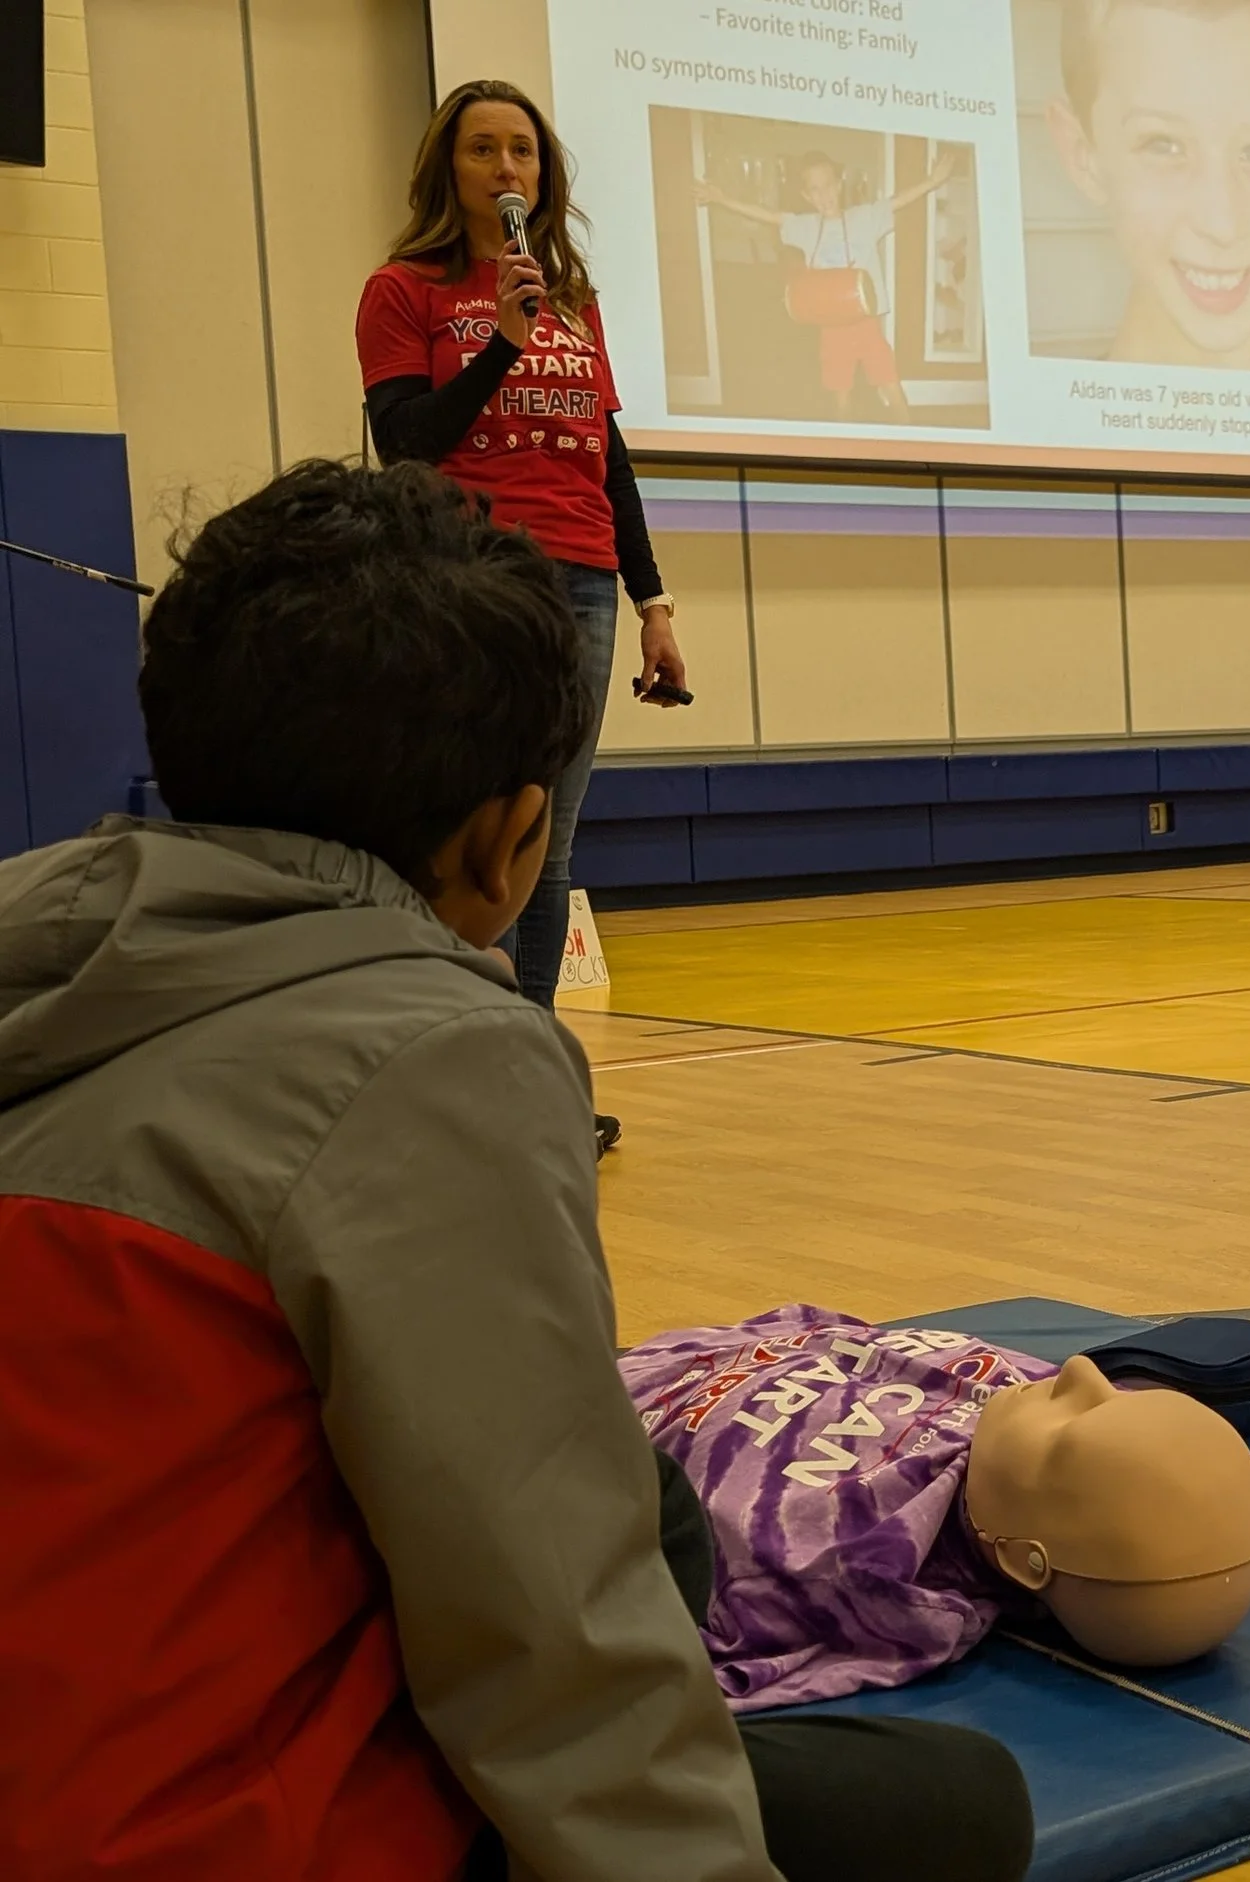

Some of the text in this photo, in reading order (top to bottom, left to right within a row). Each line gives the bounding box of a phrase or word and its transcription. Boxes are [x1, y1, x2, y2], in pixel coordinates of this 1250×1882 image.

[869, 0, 903, 21] Red
[715, 7, 795, 37] Favorite
[799, 20, 853, 50] thing:
[858, 28, 918, 59] Family
[614, 48, 997, 116] NO symptoms history of any heart issues
[448, 317, 499, 343] YO
[500, 387, 599, 419] HEART
[1069, 380, 1116, 401] Aidan
[1120, 385, 1153, 403] was
[1156, 385, 1168, 403] 7
[1172, 388, 1215, 408] years
[1218, 388, 1242, 408] old
[1101, 410, 1143, 428] heart
[1147, 412, 1217, 436] suddenly
[938, 1384, 991, 1428] eart
[781, 1383, 925, 1488] CAN
